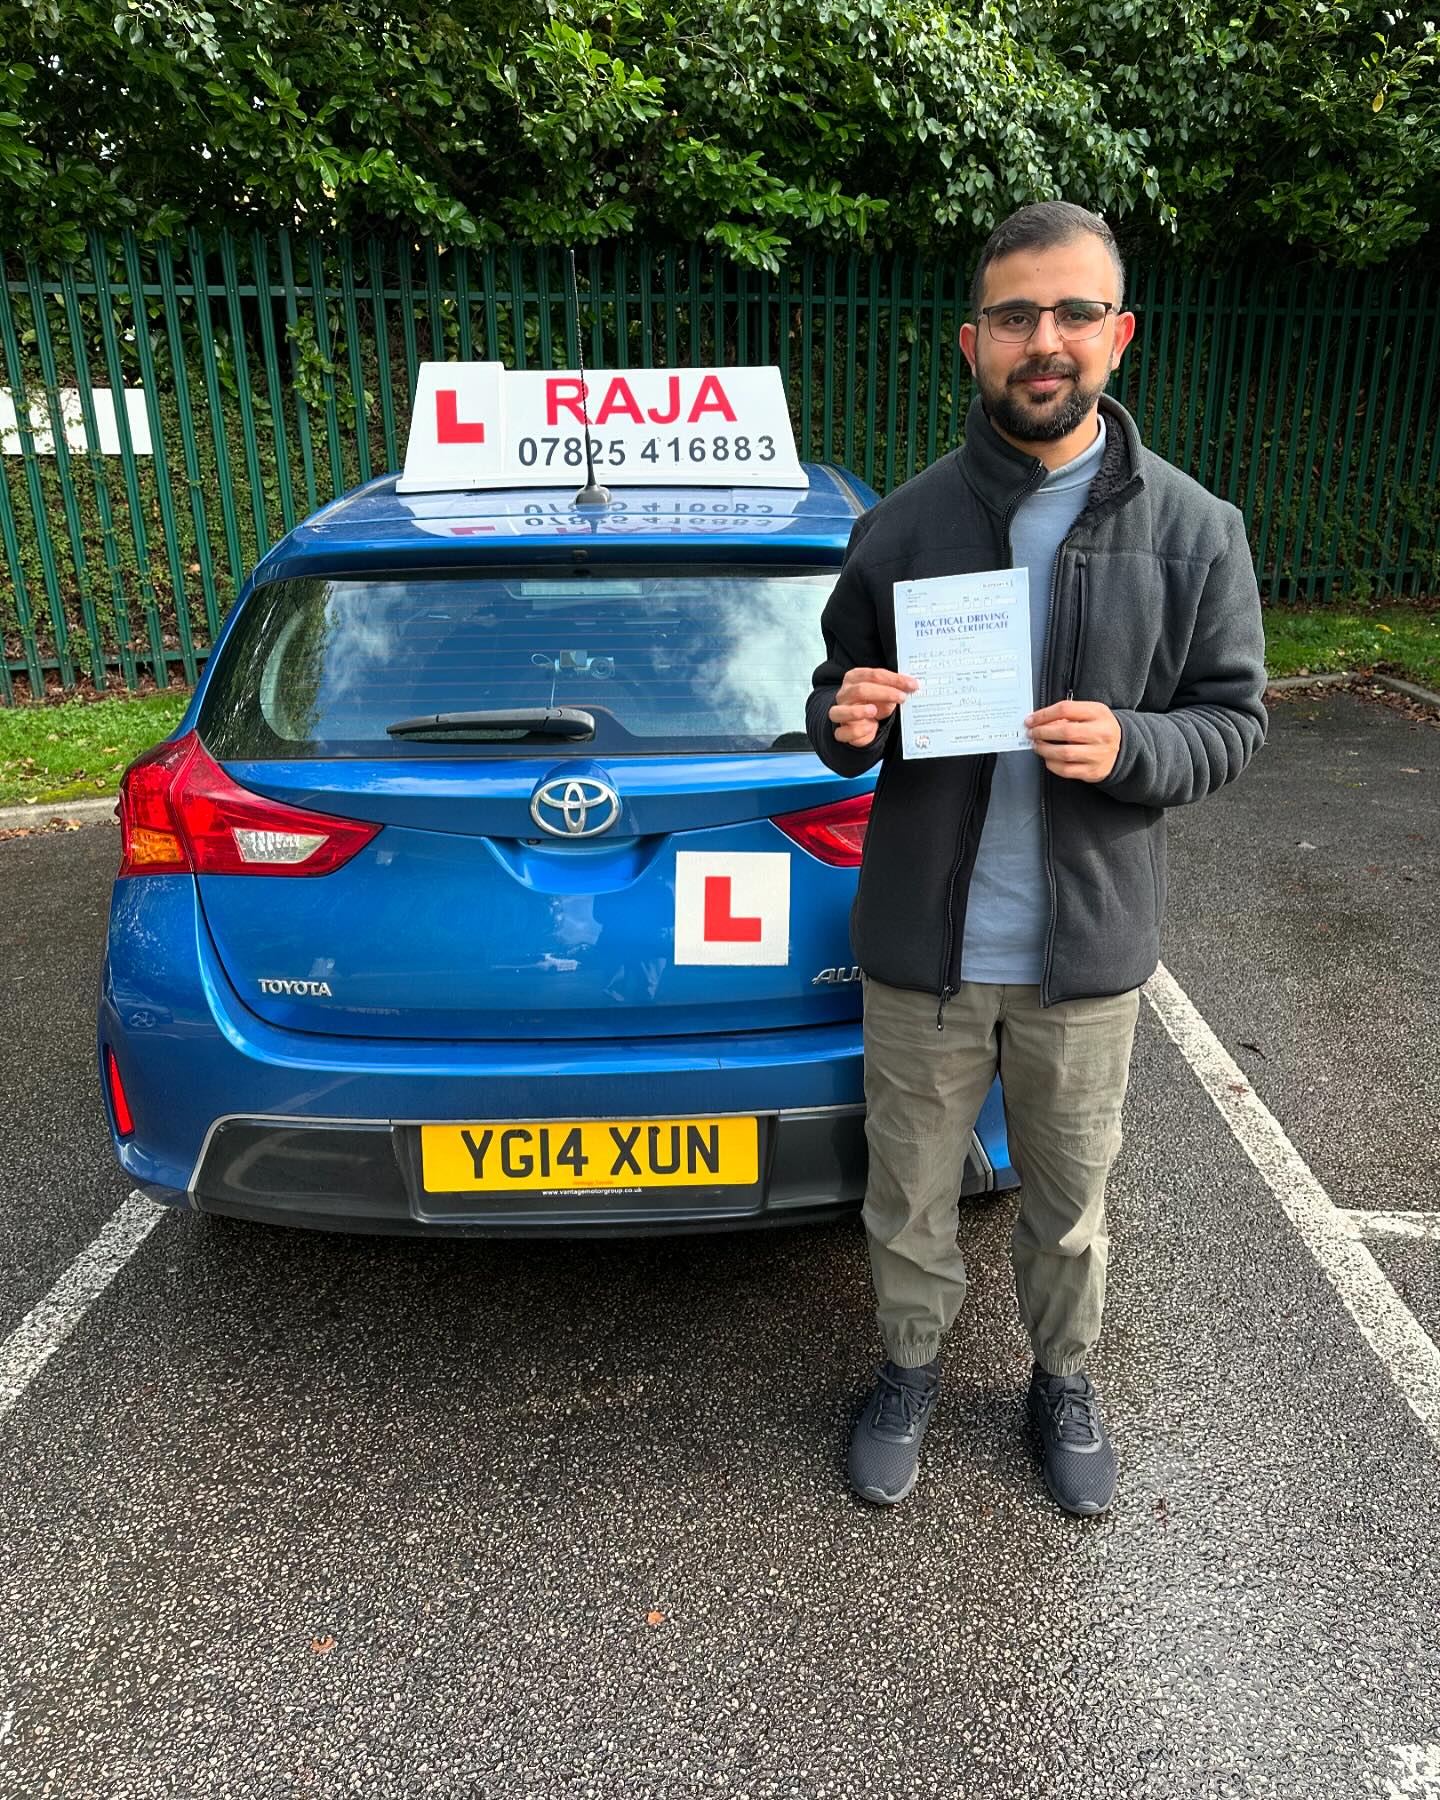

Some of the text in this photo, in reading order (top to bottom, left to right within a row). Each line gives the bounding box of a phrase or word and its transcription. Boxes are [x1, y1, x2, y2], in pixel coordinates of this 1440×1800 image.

[545, 375, 737, 426] RAJA
[435, 390, 485, 444] L
[518, 435, 776, 467] 07825 416883
[914, 611, 1009, 629] PRACTICAL DRIVING
[916, 620, 1008, 637] TEST PASS CERTIFICATE
[704, 876, 761, 942] L
[257, 978, 332, 997] TOYOTA
[460, 1125, 719, 1179] YG14 XUN
[542, 1187, 642, 1196] www.vantagemotorgroup.co.uk
